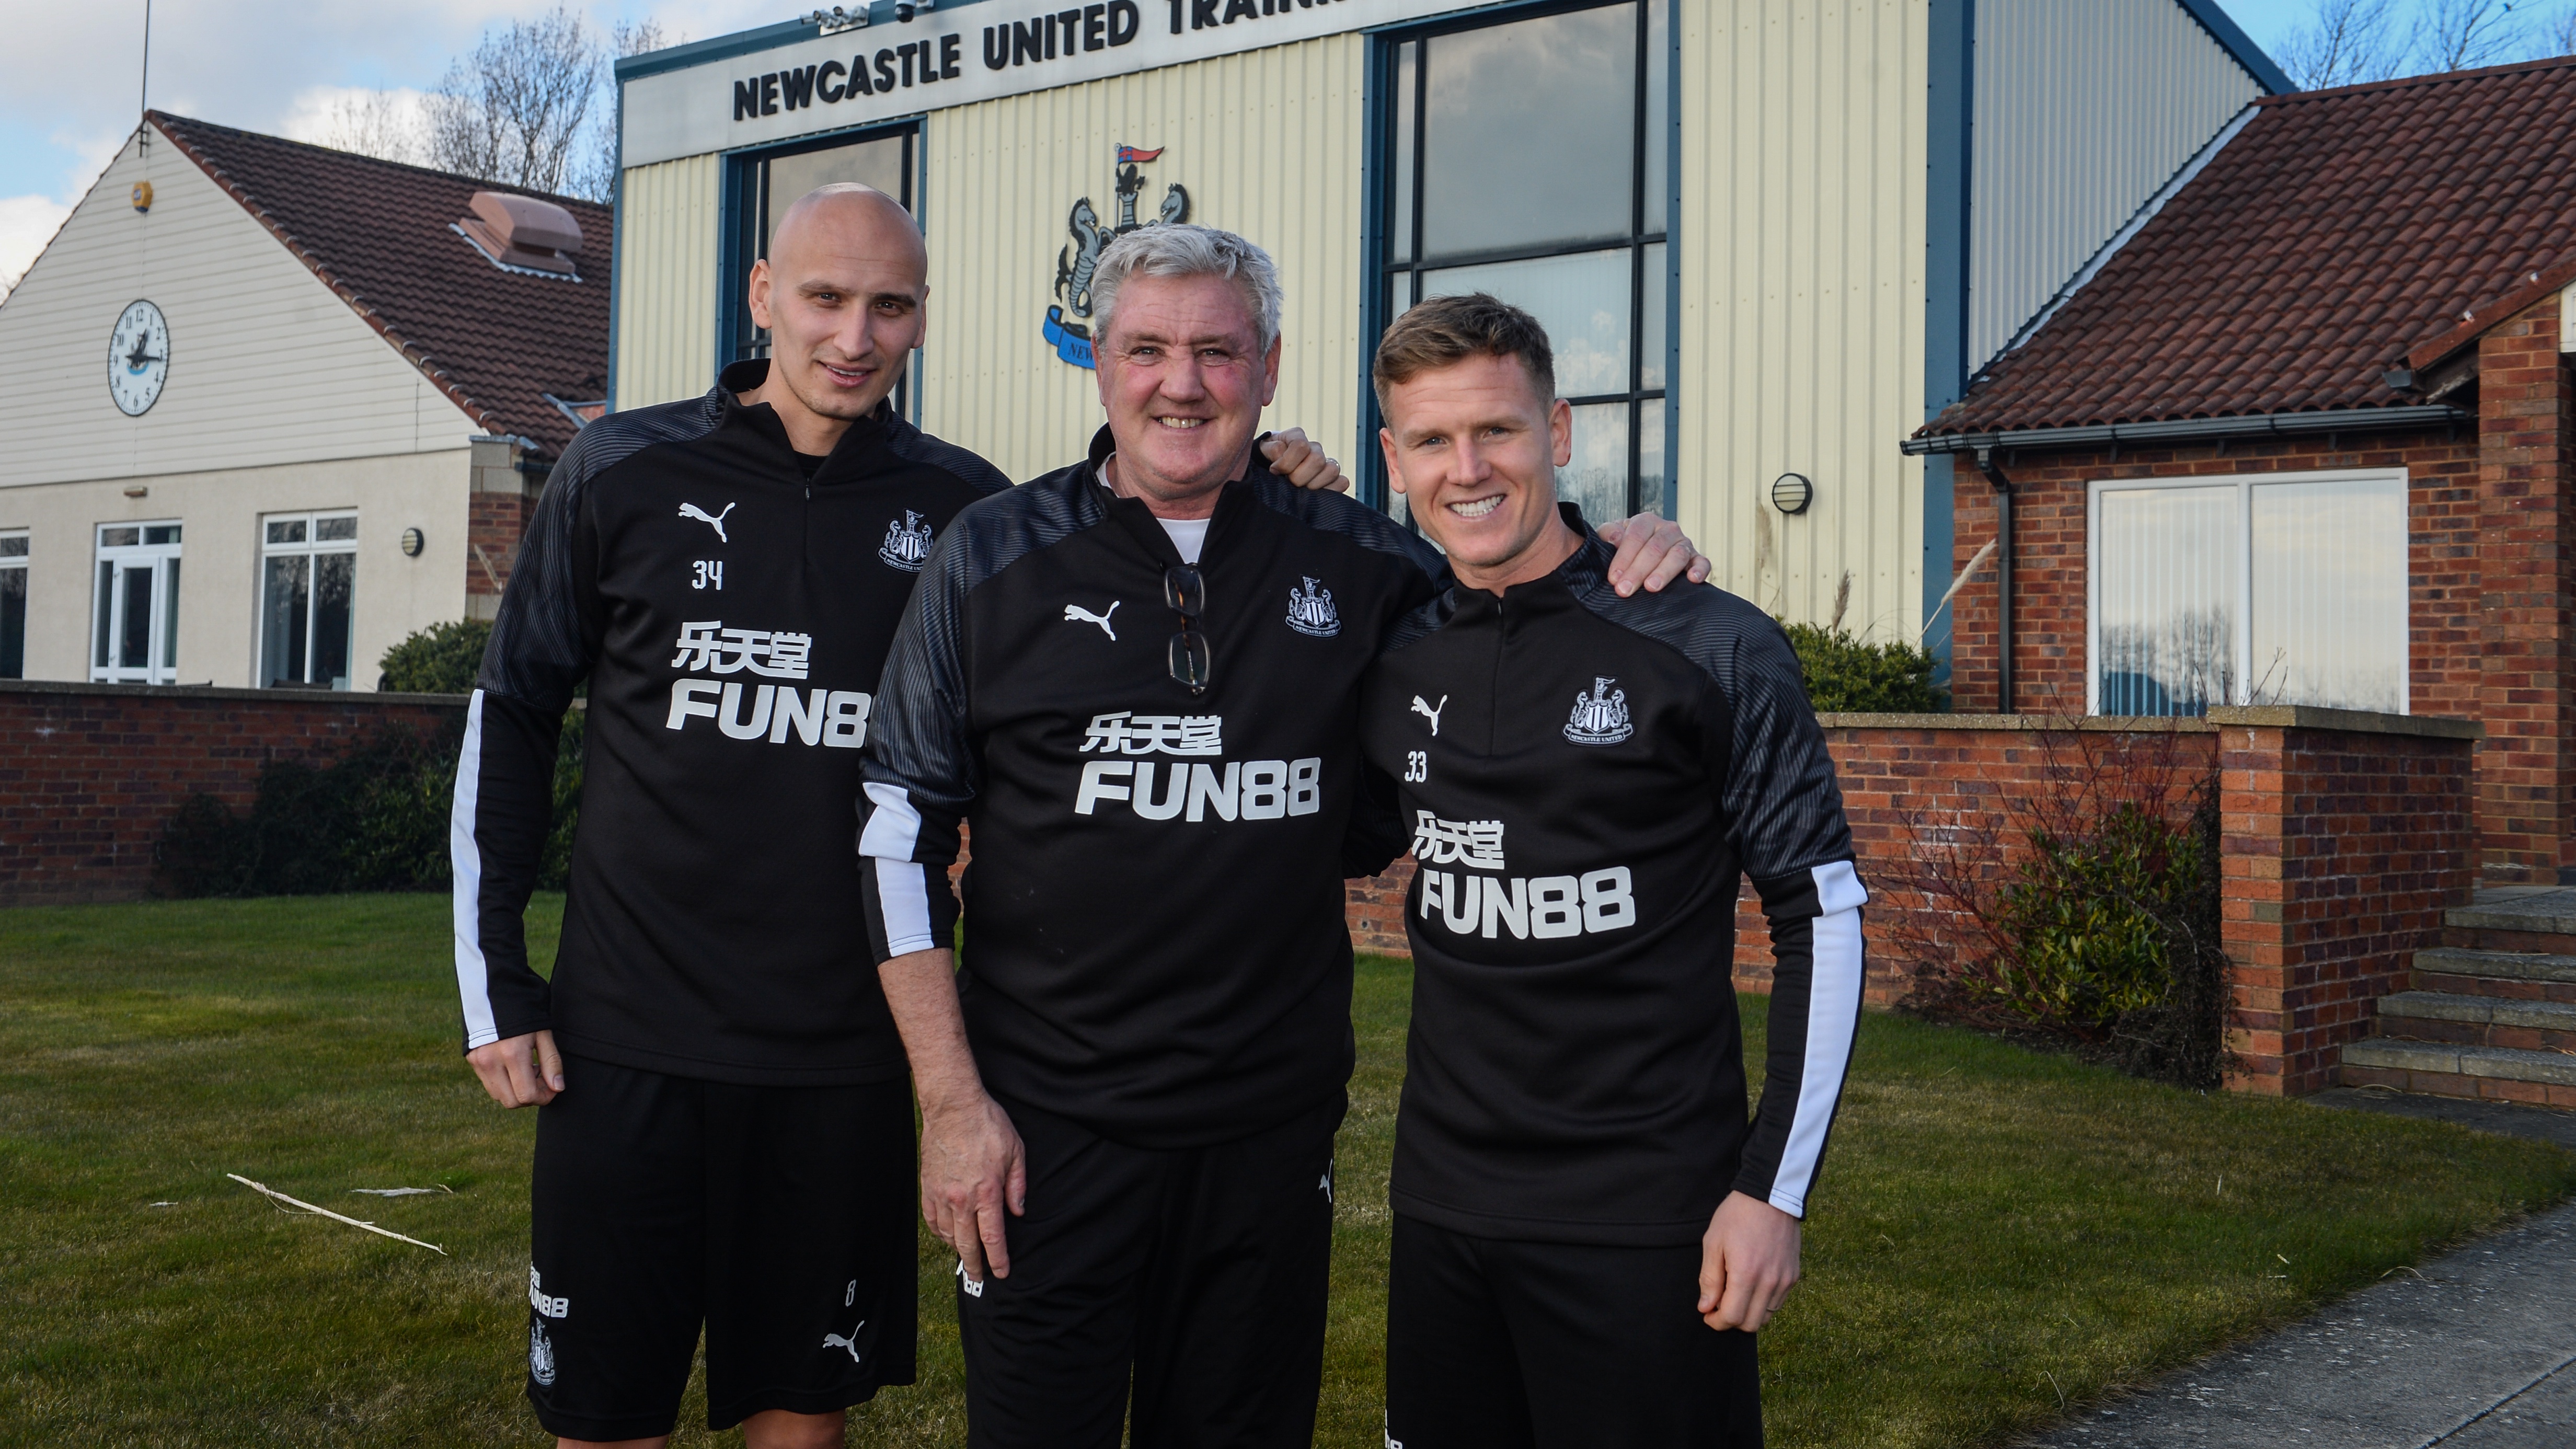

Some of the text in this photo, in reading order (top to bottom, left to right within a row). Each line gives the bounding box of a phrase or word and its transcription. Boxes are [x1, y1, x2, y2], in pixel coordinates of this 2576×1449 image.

[733, 33, 960, 121] NEWCASTLE
[983, 0, 1139, 71] UNITED
[125, 316, 132, 329] 11
[136, 308, 144, 323] 12
[117, 334, 124, 347] 10
[156, 327, 160, 340] 2
[113, 355, 118, 366] 9
[115, 375, 120, 388] 8
[154, 372, 159, 383] 4
[123, 390, 128, 402] 7
[133, 394, 139, 407] 6
[145, 388, 150, 401] 5
[887, 558, 913, 570] NEWCASTLE
[692, 560, 723, 590] 34
[1295, 625, 1322, 635] NEWCASTLE
[671, 620, 812, 680] 乐天堂
[666, 678, 877, 748] FUN8
[1078, 711, 1222, 756] 乐天堂
[1405, 751, 1427, 783] 33
[1074, 757, 1321, 822] FUN88
[1411, 809, 1505, 870] 乐天堂
[1420, 866, 1636, 940] FUN88
[845, 1279, 857, 1307] 8
